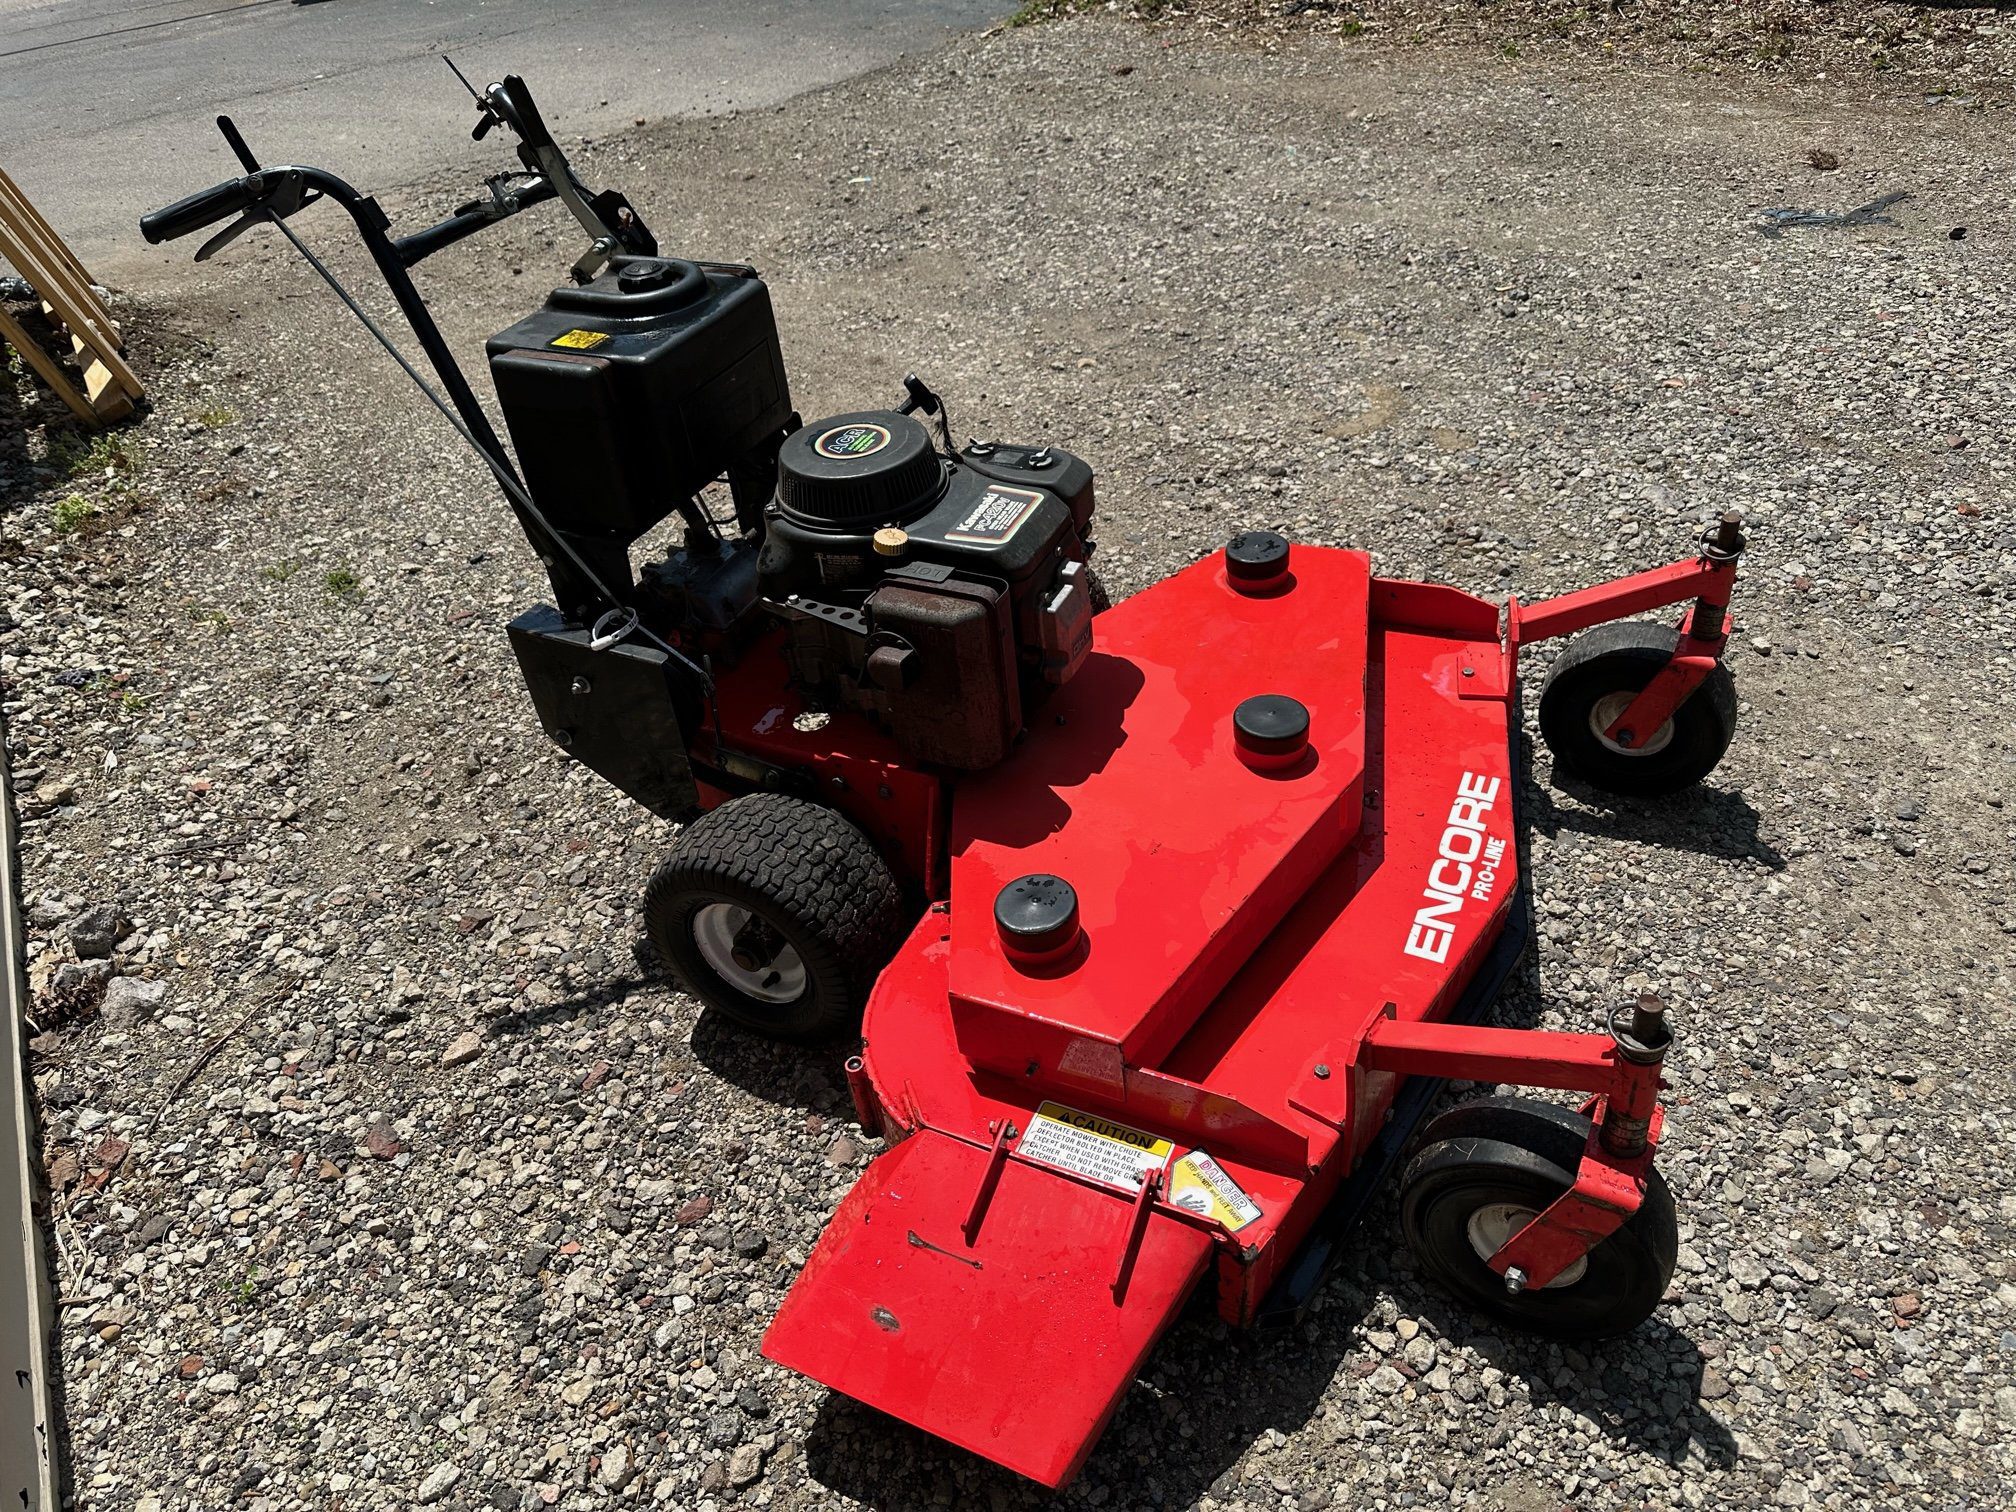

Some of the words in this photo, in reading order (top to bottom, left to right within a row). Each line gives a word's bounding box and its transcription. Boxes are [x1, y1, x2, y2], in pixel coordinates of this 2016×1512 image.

[956, 492, 999, 532] Kawasaki
[904, 563, 943, 577] HOT
[1404, 771, 1501, 964] ENCORE
[1471, 837, 1507, 902] PRO-LINE
[1037, 1128, 1074, 1145] DEFLECTOR
[1076, 1141, 1102, 1153] BOLTED
[1041, 1121, 1070, 1134] OPERATE
[1072, 1131, 1098, 1143] MOWER
[1100, 1139, 1117, 1150] WITH
[1119, 1146, 1142, 1158] CHUTE
[1074, 1116, 1152, 1149] CAUTION
[1026, 1148, 1057, 1163] CATCHER
[1058, 1159, 1077, 1170] UNTIL
[1079, 1166, 1101, 1178] BLADE
[1103, 1174, 1114, 1182] OR
[1030, 1141, 1060, 1155] CATCHER
[1066, 1153, 1076, 1161] DO
[1078, 1158, 1092, 1168] NOT
[1093, 1161, 1123, 1176] REMOVE
[1060, 1143, 1080, 1154] WHEN
[1081, 1150, 1100, 1160] USED
[1102, 1157, 1119, 1167] WITH
[1185, 1160, 1198, 1174] KEEP
[1195, 1171, 1212, 1189] HANDS
[1218, 1196, 1229, 1209] FEET
[1228, 1208, 1243, 1222] AWAY
[1199, 1159, 1248, 1210] DANGER
